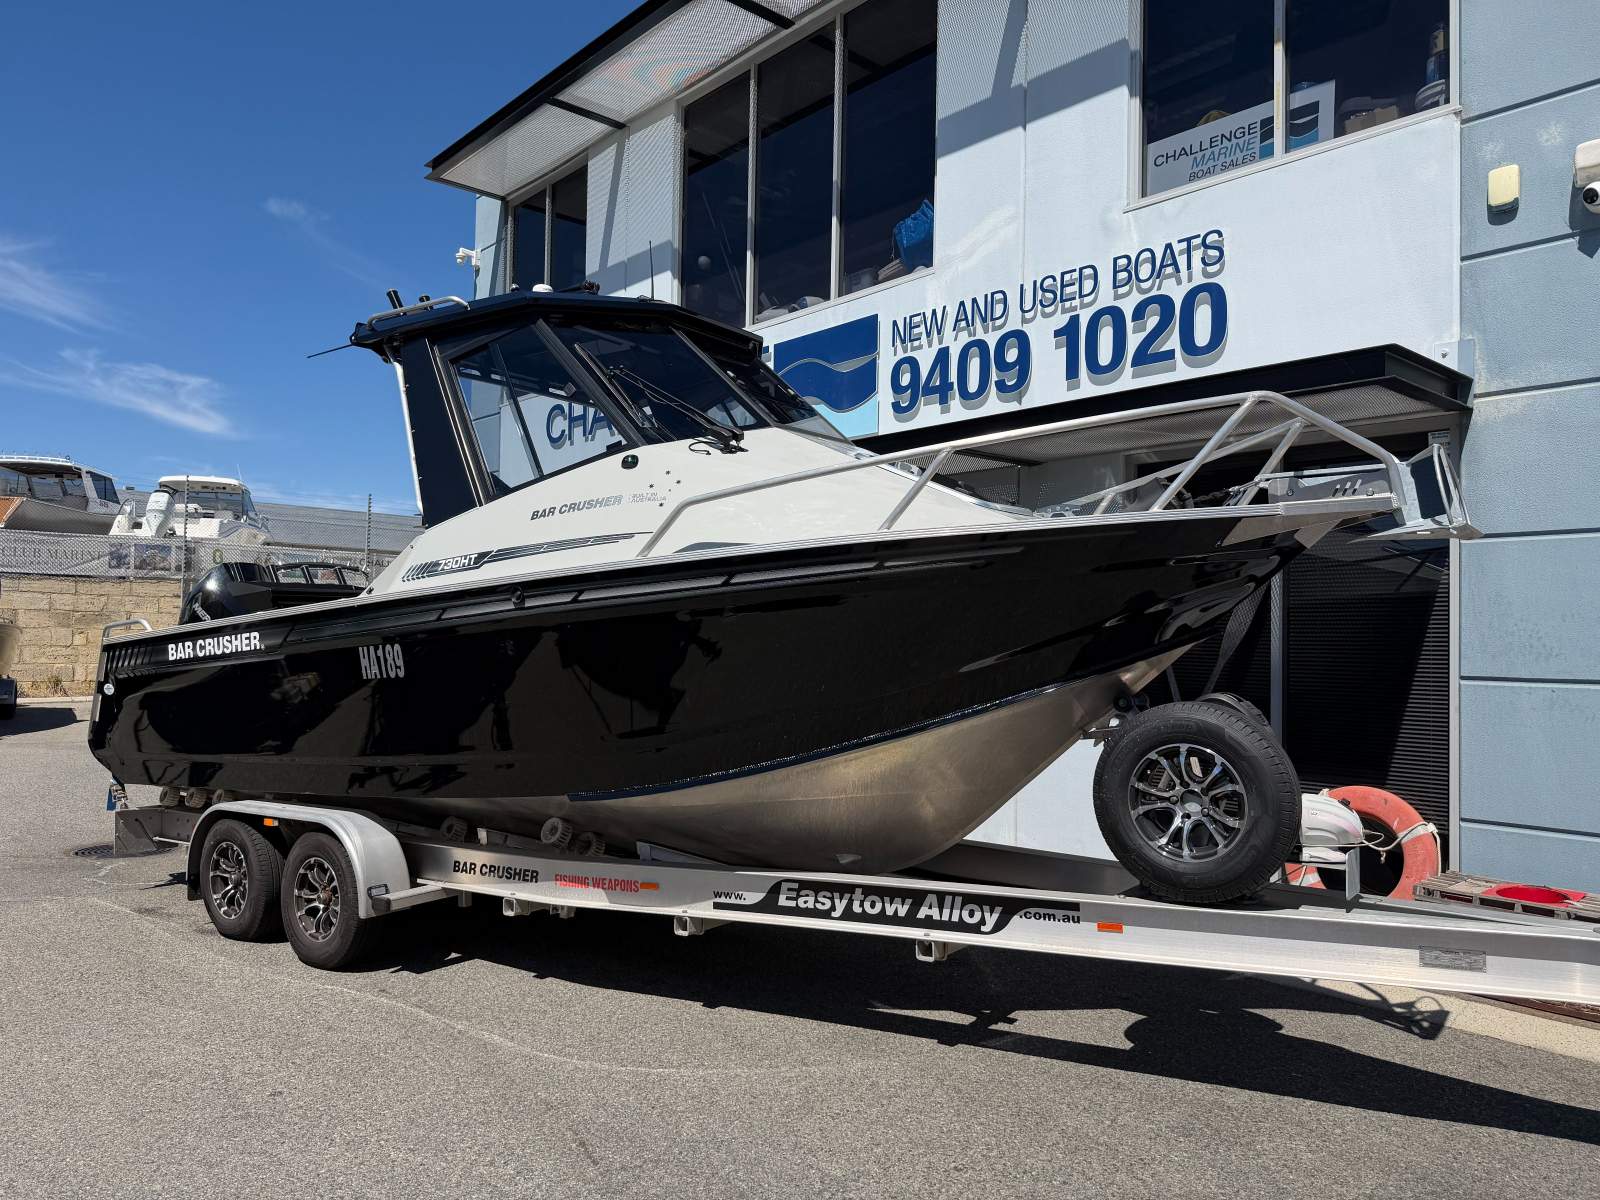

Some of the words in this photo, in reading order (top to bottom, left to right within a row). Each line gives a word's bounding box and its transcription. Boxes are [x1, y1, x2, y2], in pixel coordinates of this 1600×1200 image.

[1153, 121, 1258, 168] CHALLENGE
[1191, 136, 1258, 170] MARINE
[1188, 164, 1218, 182] BOAT
[1220, 152, 1257, 172] SALES
[891, 305, 947, 348] NEW
[952, 289, 1009, 333] AND
[1019, 264, 1099, 315] USED
[1112, 229, 1225, 291] BOATS
[890, 328, 1032, 416] 9409
[1053, 281, 1229, 384] 1020
[530, 506, 557, 521] BAR
[558, 494, 624, 515] CRUSHER
[438, 553, 478, 571] 730HT
[168, 641, 194, 660] BAR
[196, 632, 260, 657] CRUSHER
[358, 643, 405, 680] HA189
[452, 860, 477, 875] BAR
[479, 863, 540, 883] CRUSHER
[554, 873, 590, 888] FISHING
[592, 876, 641, 893] WEAPONS
[712, 890, 747, 901] www.
[777, 881, 913, 918] Easytow
[916, 893, 1003, 932] Alloy
[1018, 909, 1081, 924] .com.au
